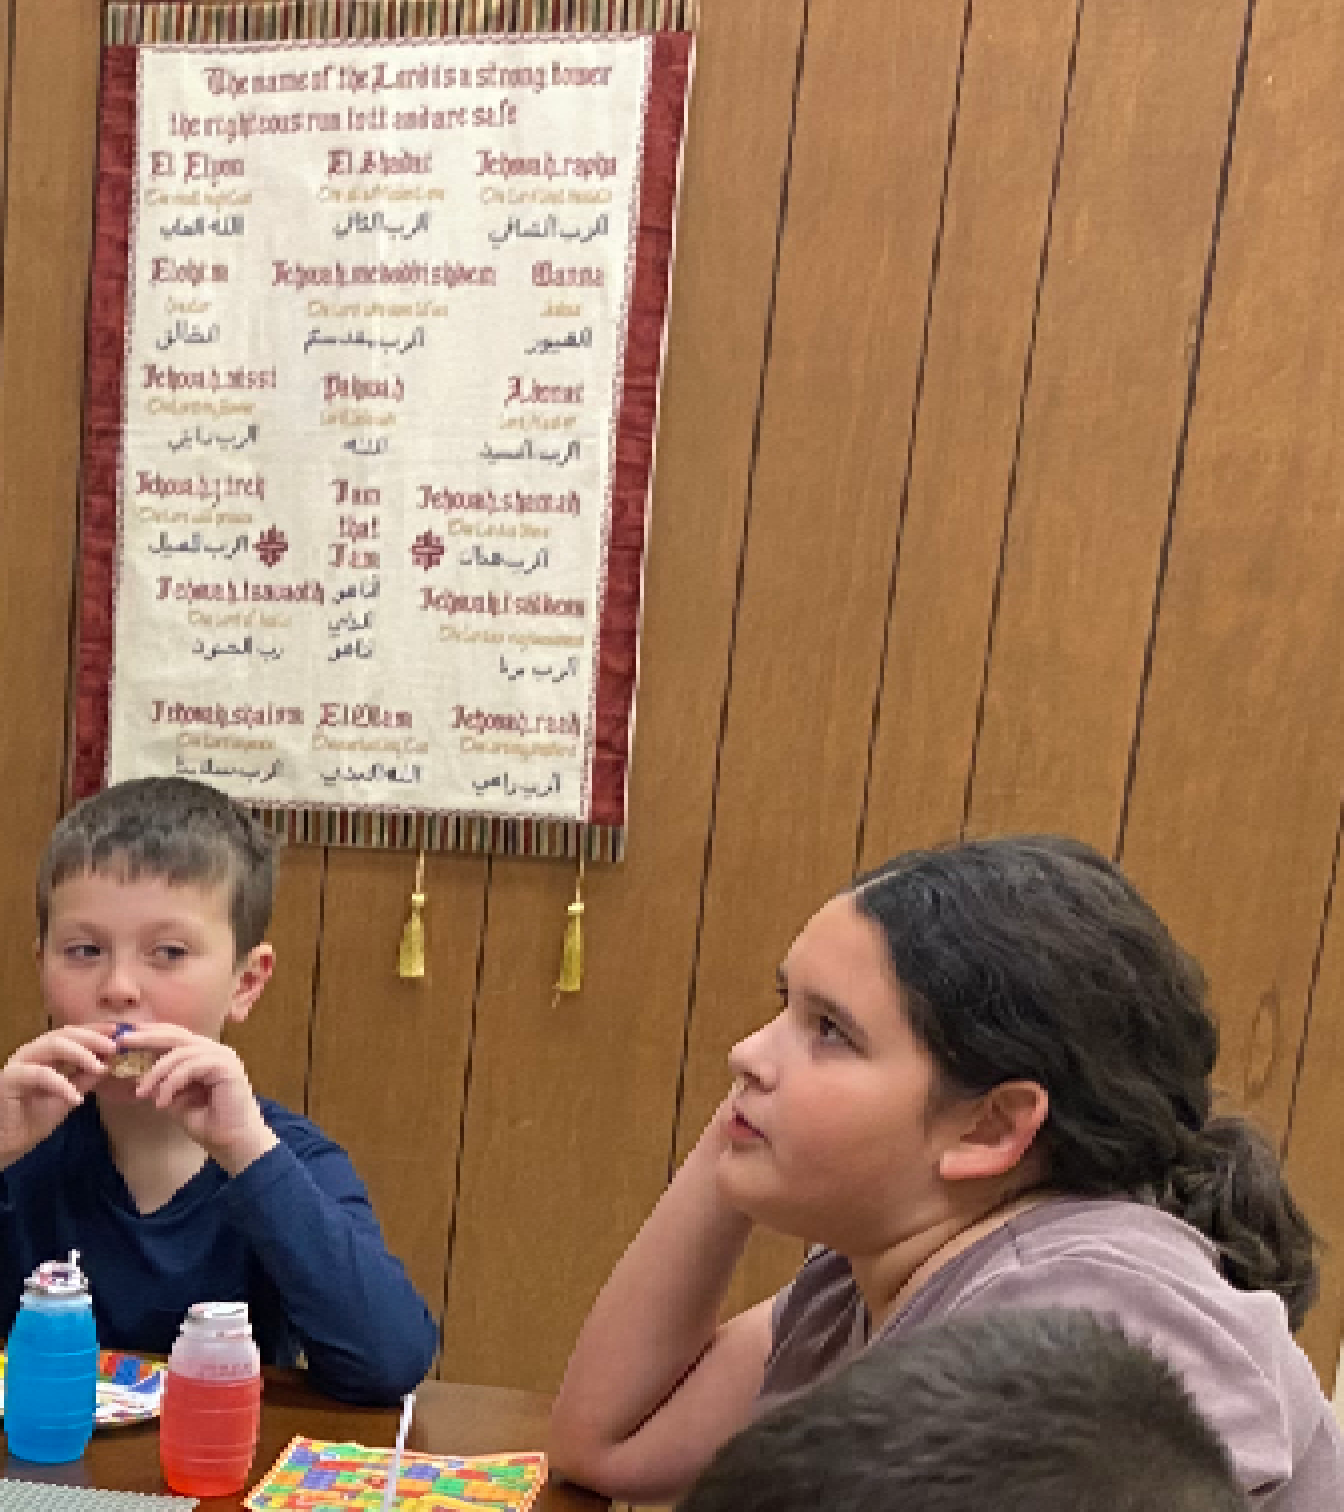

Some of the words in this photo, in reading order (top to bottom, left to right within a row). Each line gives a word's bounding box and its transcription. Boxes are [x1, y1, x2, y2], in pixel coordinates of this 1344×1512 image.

[202, 67, 248, 100] The
[251, 73, 308, 93] name
[339, 64, 368, 94] the
[372, 60, 428, 92] Lord
[475, 61, 546, 94] strong
[551, 60, 612, 87] tower
[170, 112, 200, 141] the
[204, 111, 303, 146] righteous
[308, 112, 340, 132] run
[393, 105, 429, 130] and
[432, 107, 466, 129] are
[472, 97, 517, 128] safe
[150, 150, 174, 176] El
[327, 149, 354, 177] El
